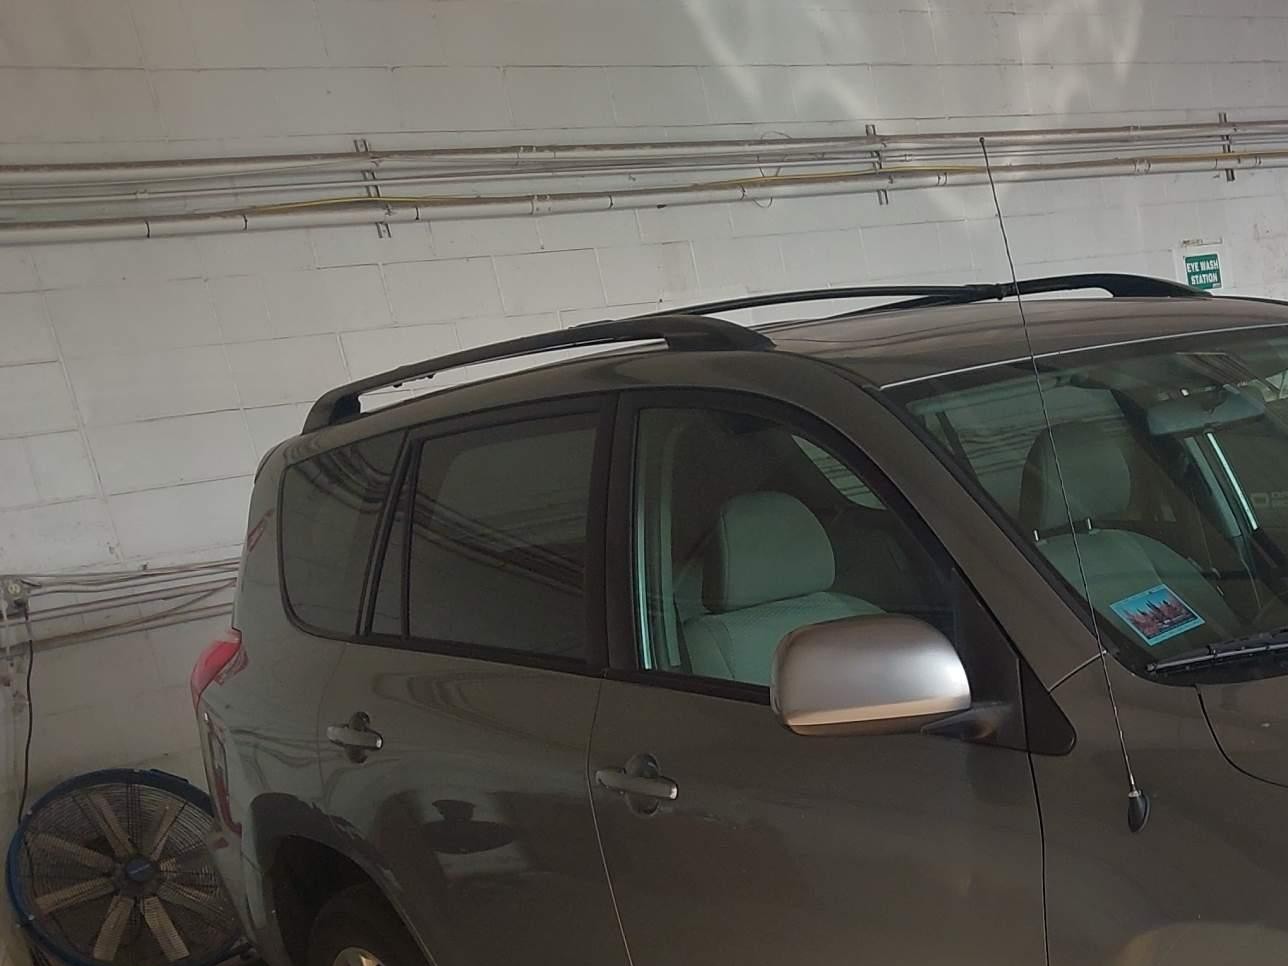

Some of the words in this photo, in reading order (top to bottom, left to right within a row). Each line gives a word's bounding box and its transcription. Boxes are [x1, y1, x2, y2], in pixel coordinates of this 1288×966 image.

[1187, 261, 1200, 273] EYE
[1200, 259, 1219, 271] WASH
[1191, 272, 1218, 285] STATION
